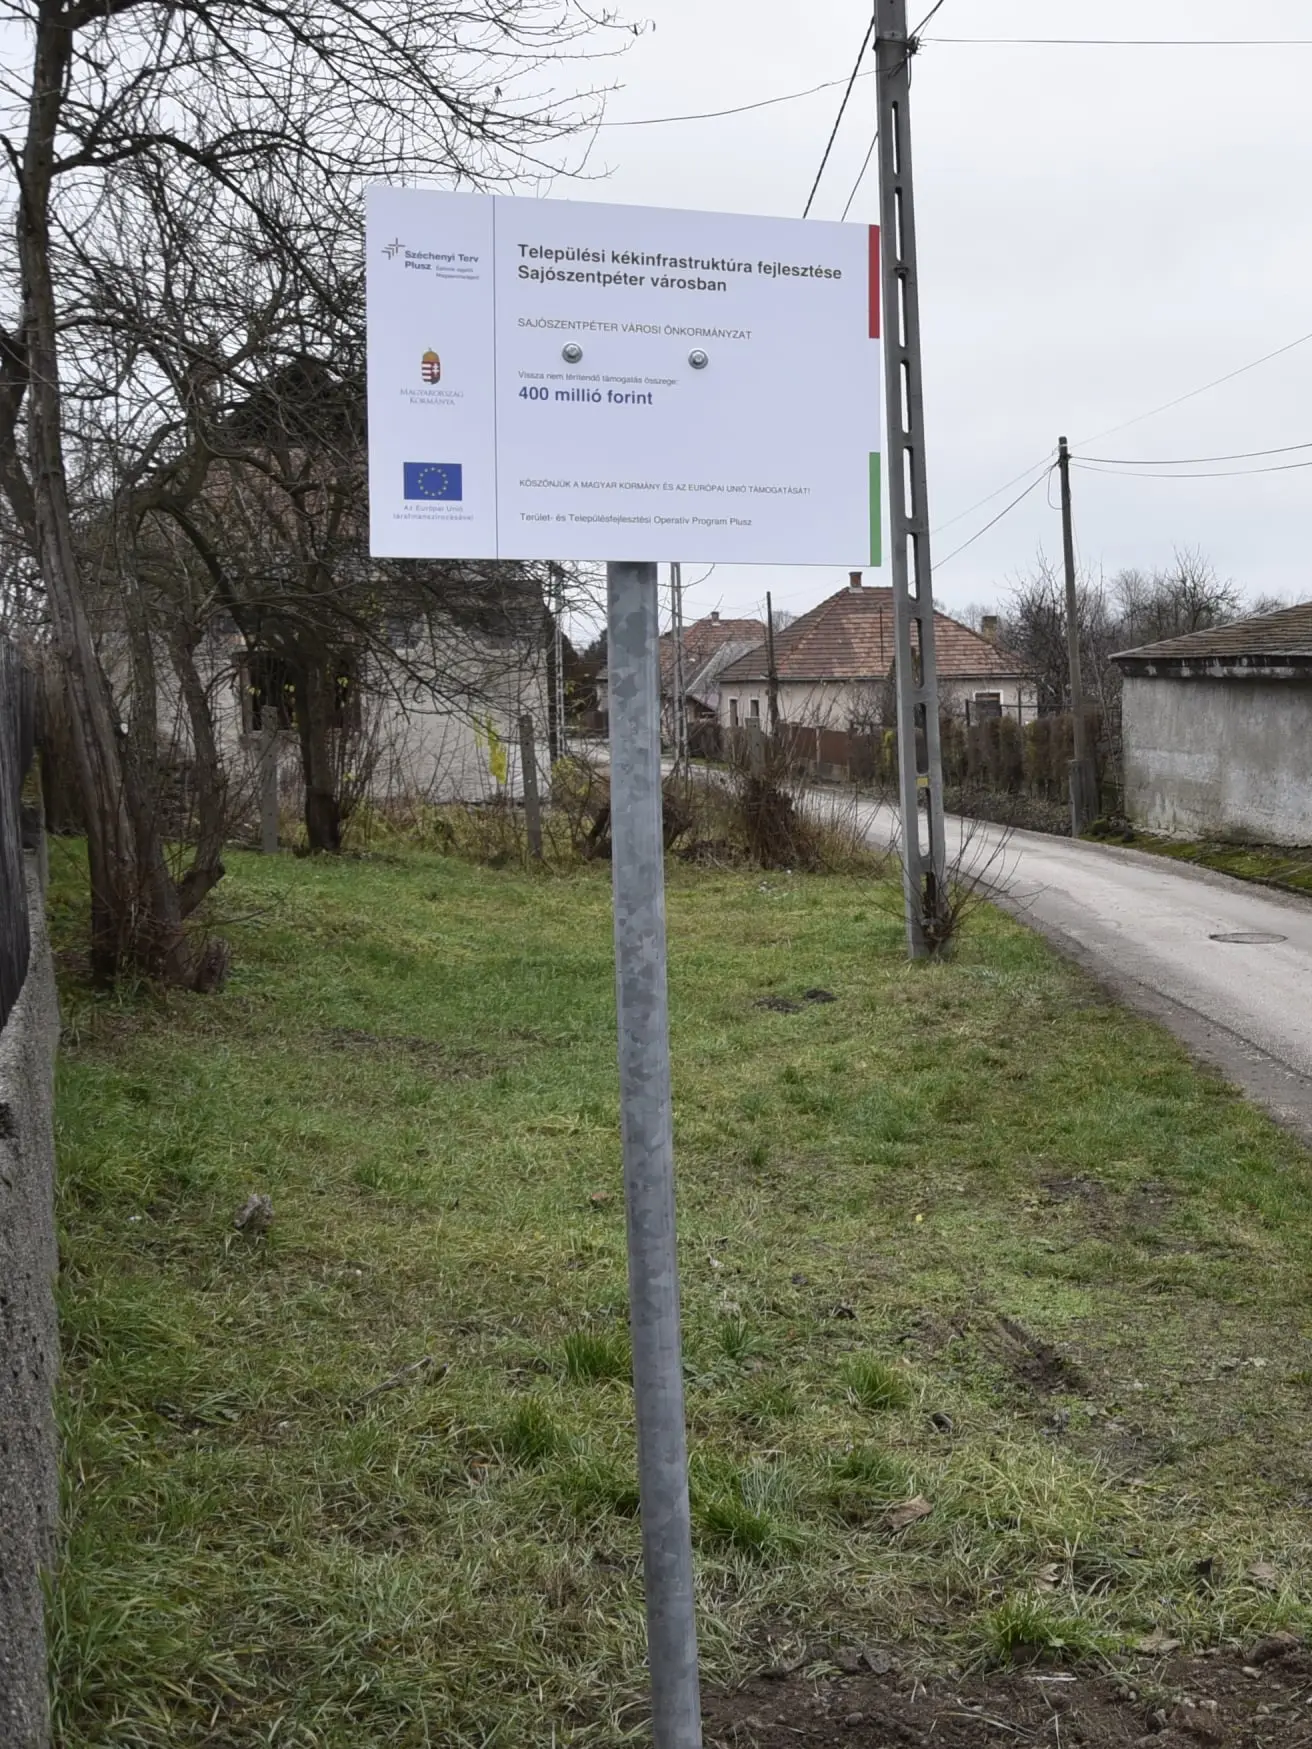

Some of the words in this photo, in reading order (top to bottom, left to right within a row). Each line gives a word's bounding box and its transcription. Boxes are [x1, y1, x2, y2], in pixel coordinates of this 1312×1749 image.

[404, 250, 455, 262] Széchenyi
[458, 253, 479, 262] Terv
[517, 243, 605, 263] Települési
[611, 250, 752, 273] kékinfrastruktúra
[757, 261, 842, 279] fejlesztése
[404, 260, 432, 270] Plusz
[518, 265, 645, 287] Sajószentpéter
[650, 274, 727, 292] városban
[517, 317, 618, 332] SAJÓSZENTPÉTER
[621, 322, 661, 334] VÁROSI
[664, 324, 752, 340] ÖNKORMÁNYZAT
[518, 371, 545, 380] Vissza
[518, 386, 549, 400] 400
[555, 387, 602, 403] millió
[607, 390, 653, 405] forint
[519, 478, 571, 488] KÖSZÖNJÜK
[572, 480, 580, 488] A
[580, 481, 617, 489] MAGYAR
[619, 481, 660, 490] KORMÁNY
[662, 482, 674, 491] ÉS
[675, 483, 687, 492] AZ
[688, 483, 725, 493] EURÓPAI
[726, 484, 747, 493] UNIÓ
[519, 512, 554, 522] Terület-
[555, 513, 567, 522] és
[568, 513, 652, 525] Településfejlesztési
[653, 515, 690, 525] Operatív
[691, 516, 728, 527] Program
[729, 517, 753, 526] Plusz
